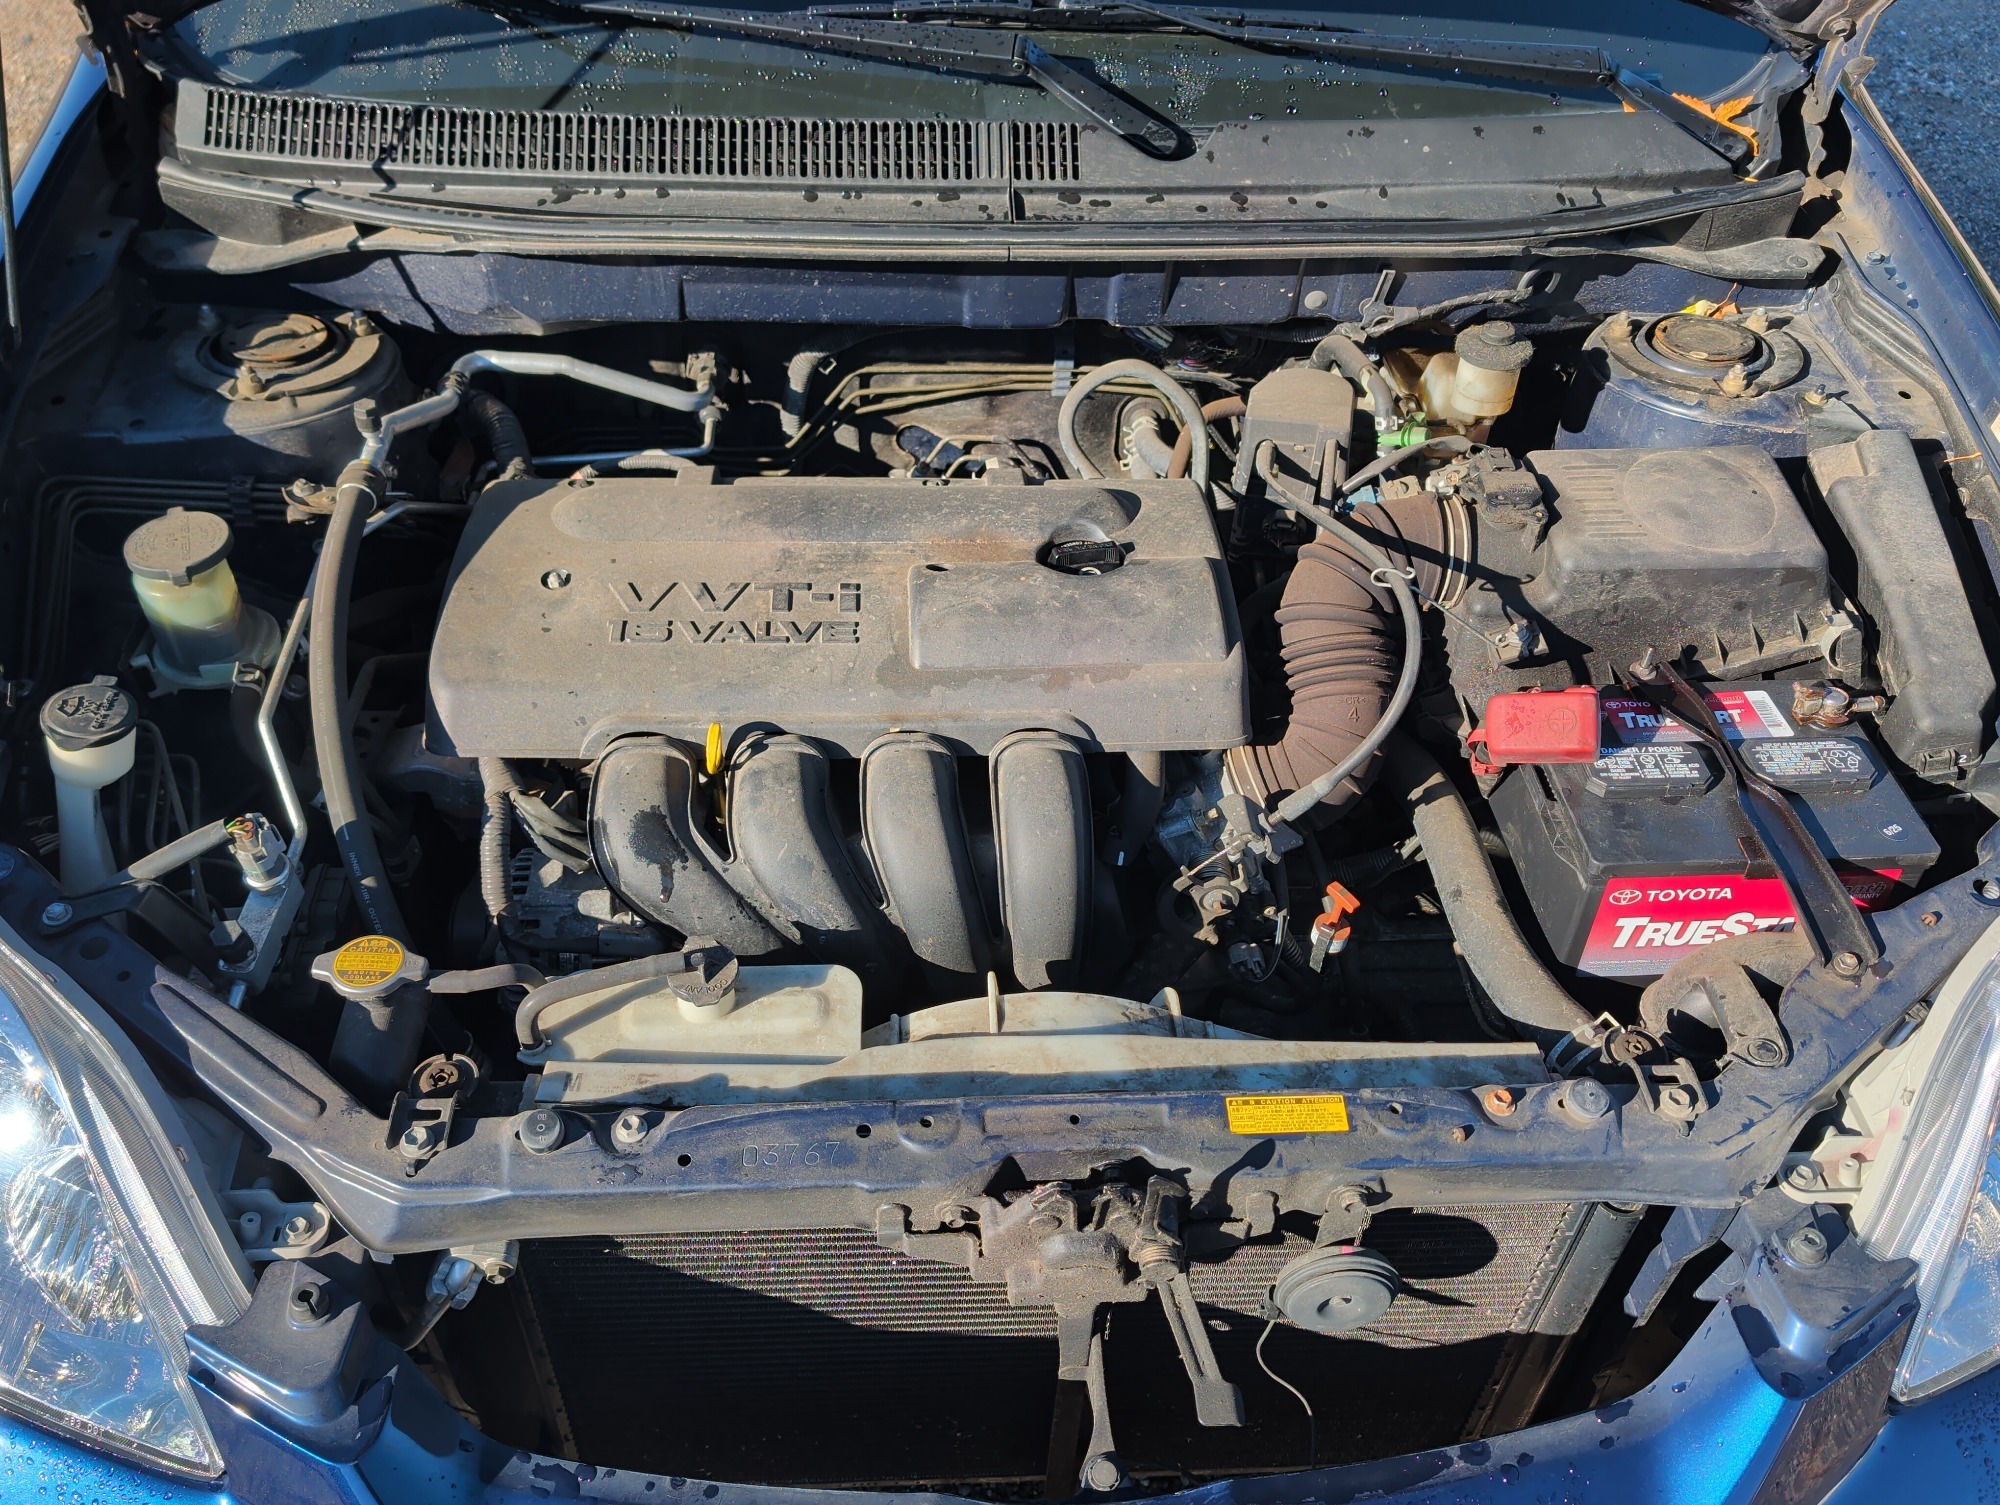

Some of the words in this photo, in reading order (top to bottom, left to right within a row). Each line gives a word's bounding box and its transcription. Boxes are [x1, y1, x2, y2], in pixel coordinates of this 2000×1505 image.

[608, 620, 673, 643] 16
[677, 620, 861, 644] VALVE
[1347, 706, 1360, 723] 4
[1957, 754, 1968, 763] 2
[1882, 823, 1903, 836] 6/25
[348, 852, 362, 877] INNER
[368, 907, 384, 934] OUTER
[1646, 887, 1733, 903] TOYOTA
[349, 946, 396, 954] CAUTION
[684, 978, 728, 994] COOLANT
[742, 1141, 840, 1167] 03767
